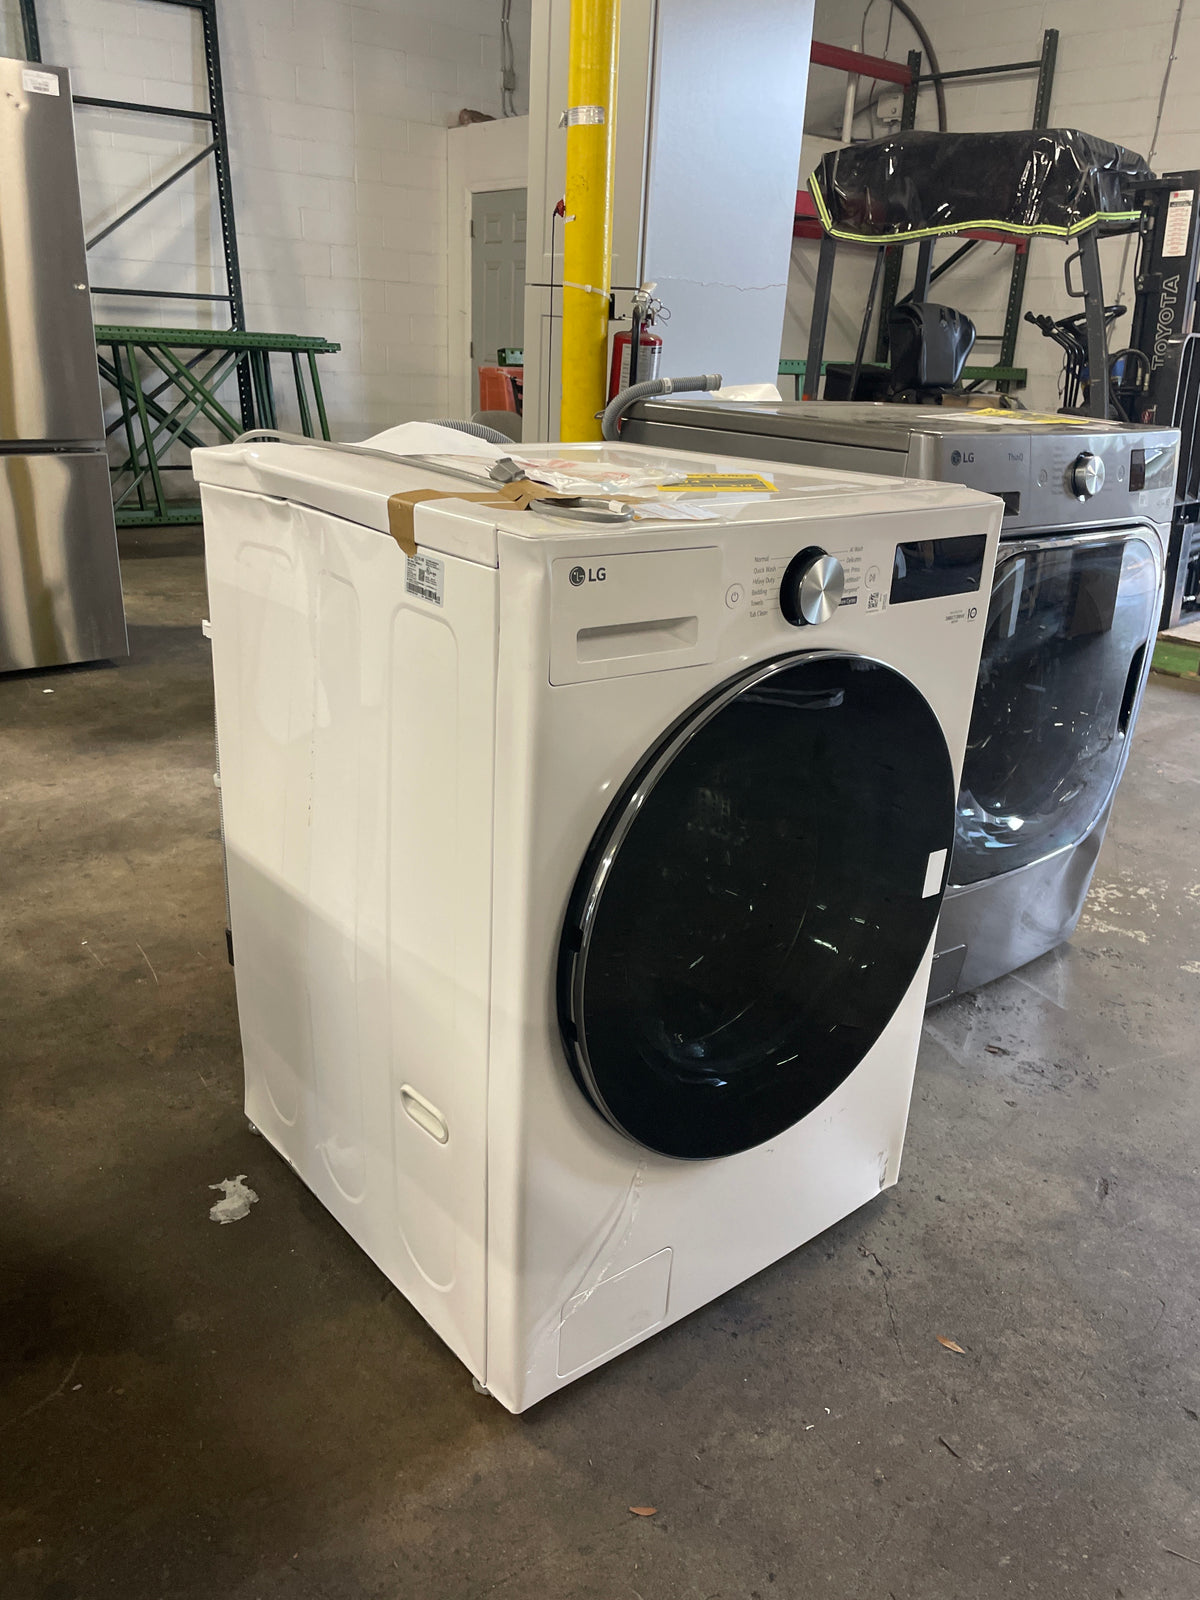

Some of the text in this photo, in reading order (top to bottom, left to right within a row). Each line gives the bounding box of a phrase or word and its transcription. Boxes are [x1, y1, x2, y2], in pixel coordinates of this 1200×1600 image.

[1152, 274, 1181, 371] TOYOTA
[963, 453, 975, 463] LG
[588, 567, 606, 582] LG
